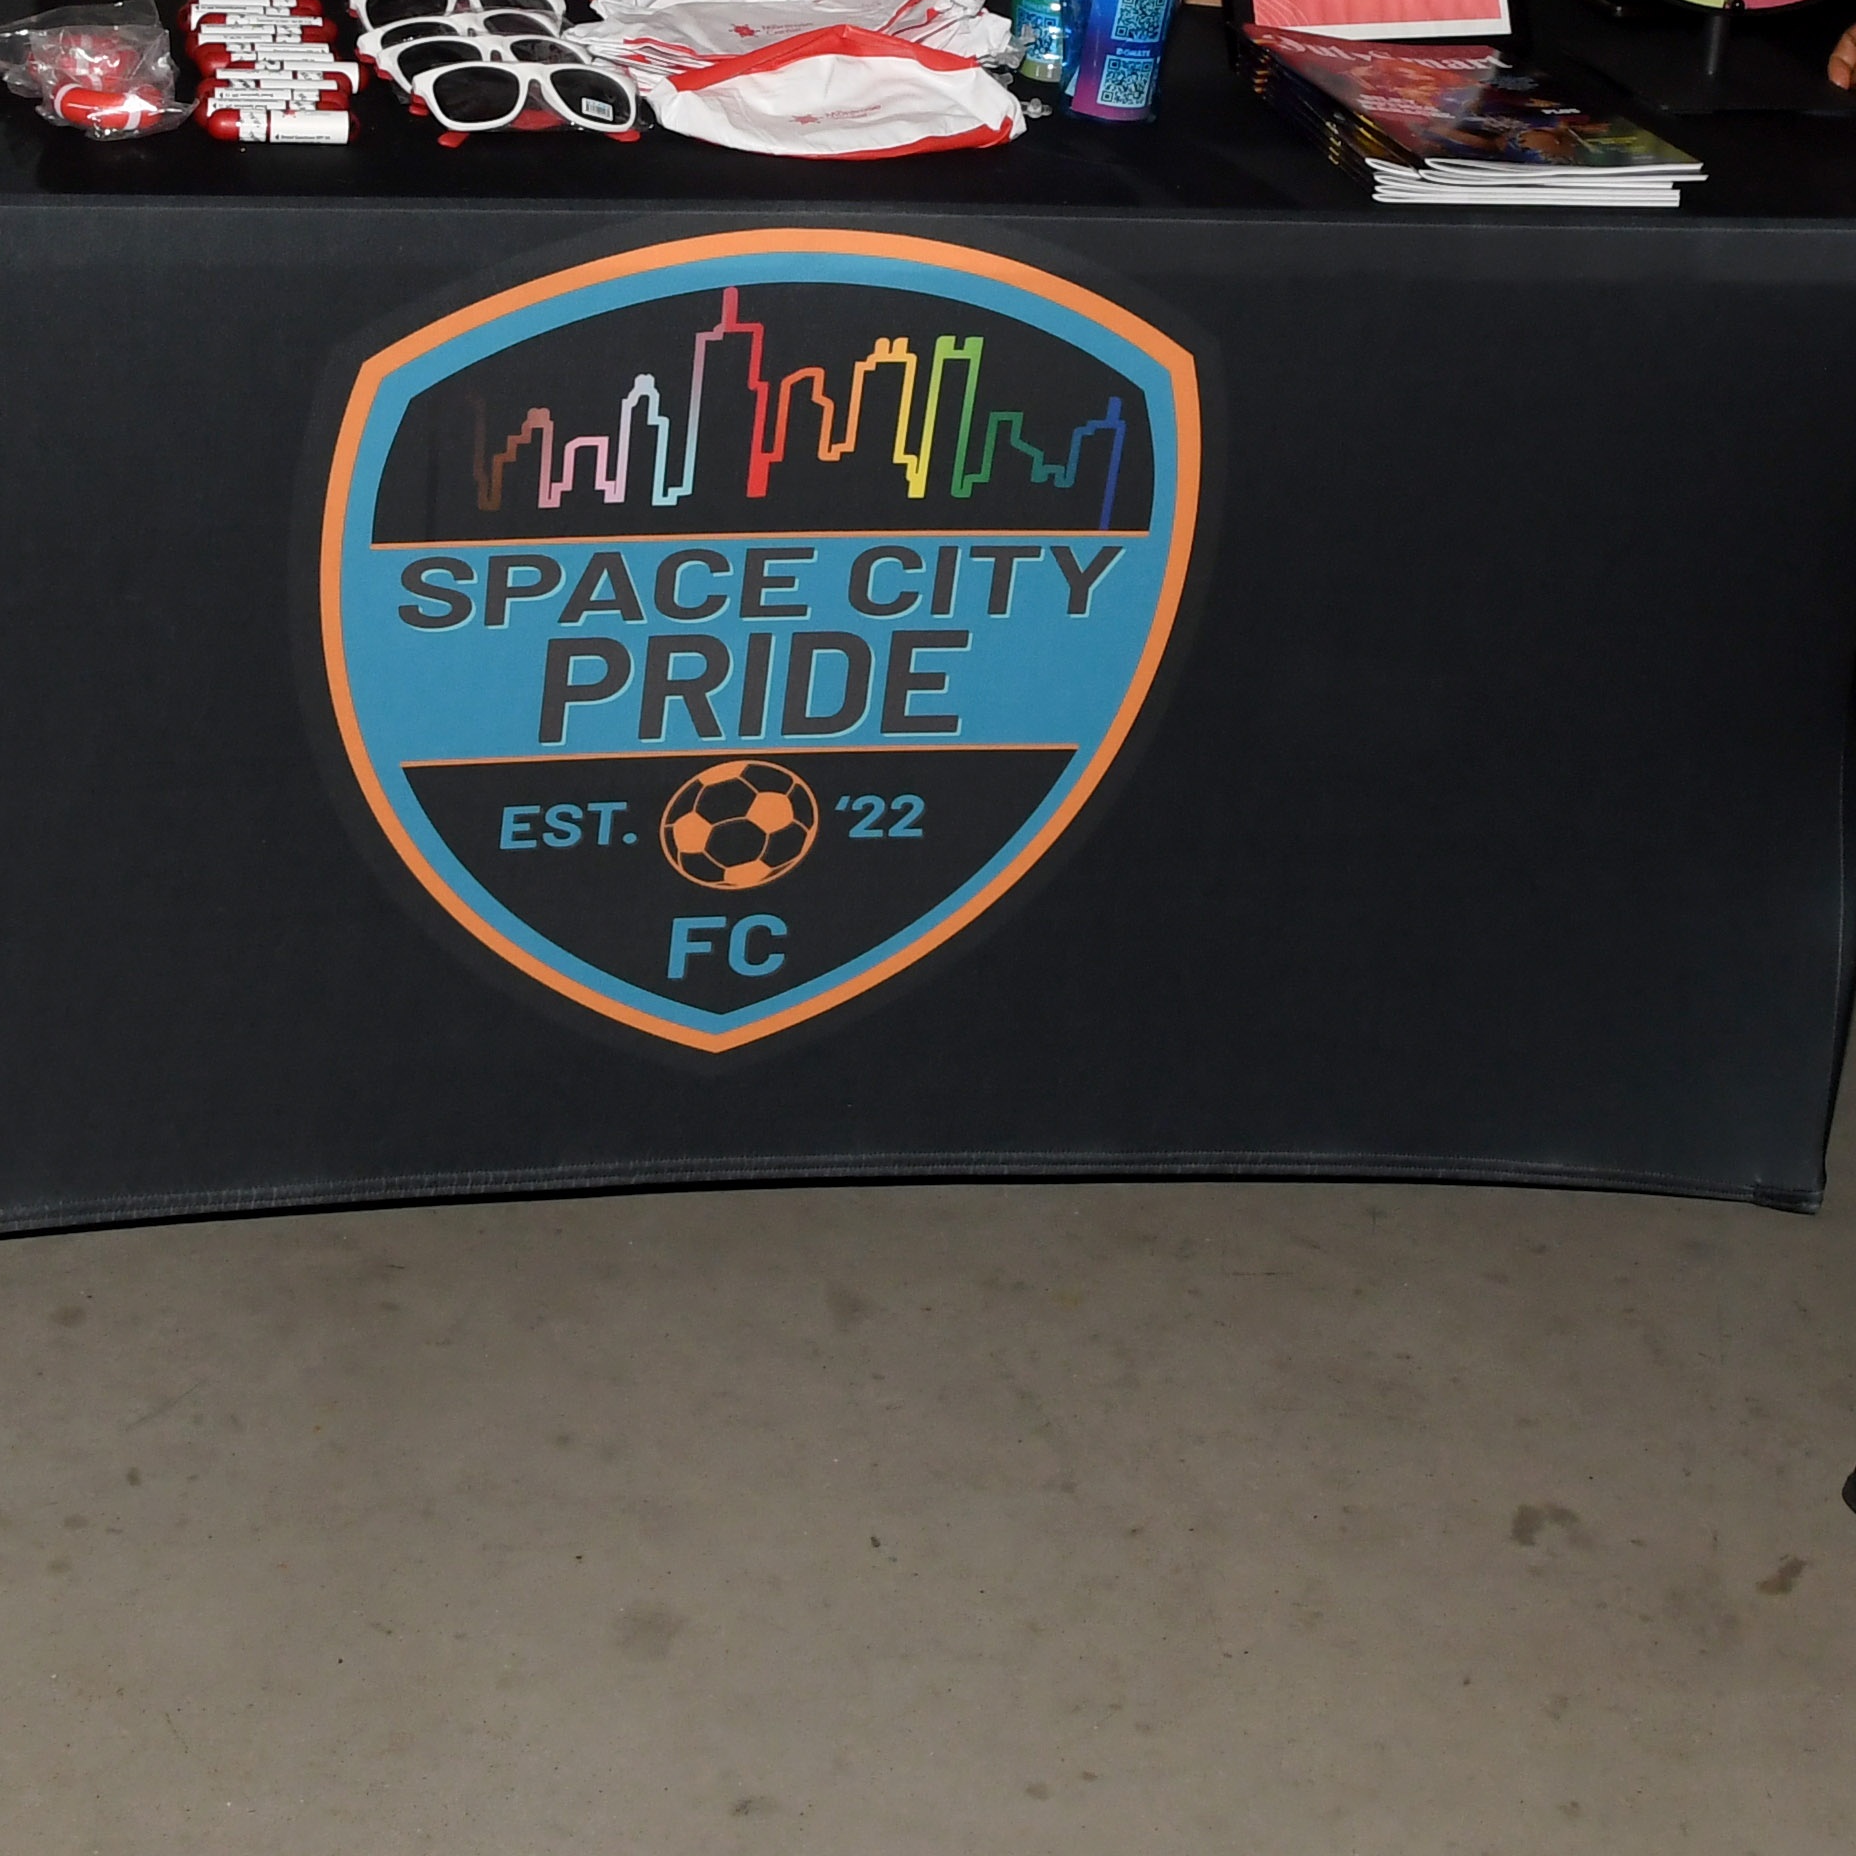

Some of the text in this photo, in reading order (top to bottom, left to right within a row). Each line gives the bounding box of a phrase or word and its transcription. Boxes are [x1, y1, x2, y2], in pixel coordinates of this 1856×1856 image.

[397, 544, 1128, 632] SPACE CITY
[537, 629, 973, 746] PRIDE
[497, 802, 640, 853] EST.
[666, 913, 790, 981] FC
